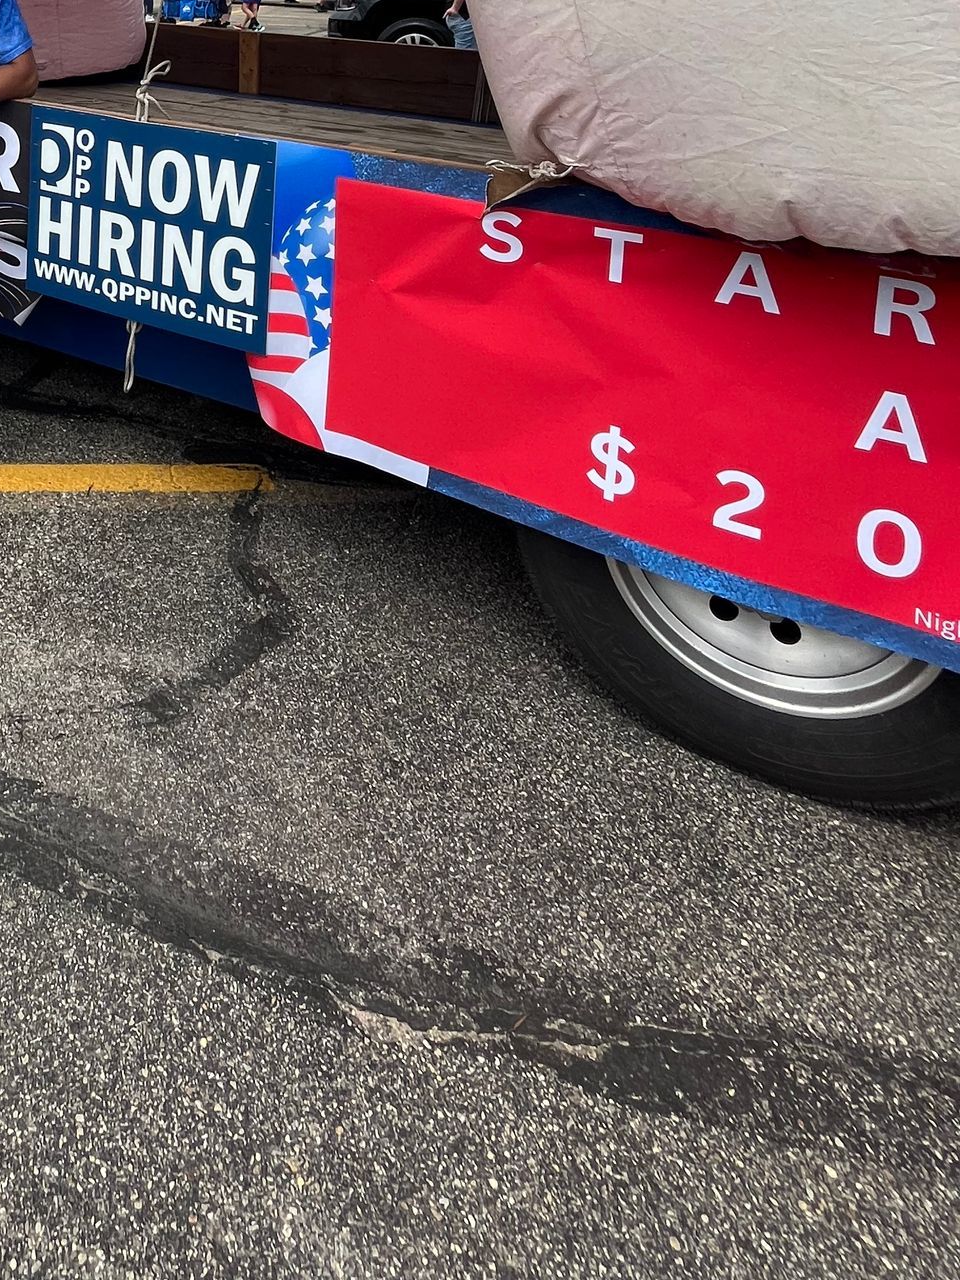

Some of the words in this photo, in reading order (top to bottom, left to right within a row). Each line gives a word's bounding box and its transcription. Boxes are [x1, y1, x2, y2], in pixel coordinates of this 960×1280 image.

[104, 140, 260, 228] NOW
[37, 196, 257, 307] HIRING
[33, 258, 259, 335] WWW.QPPINC.NET
